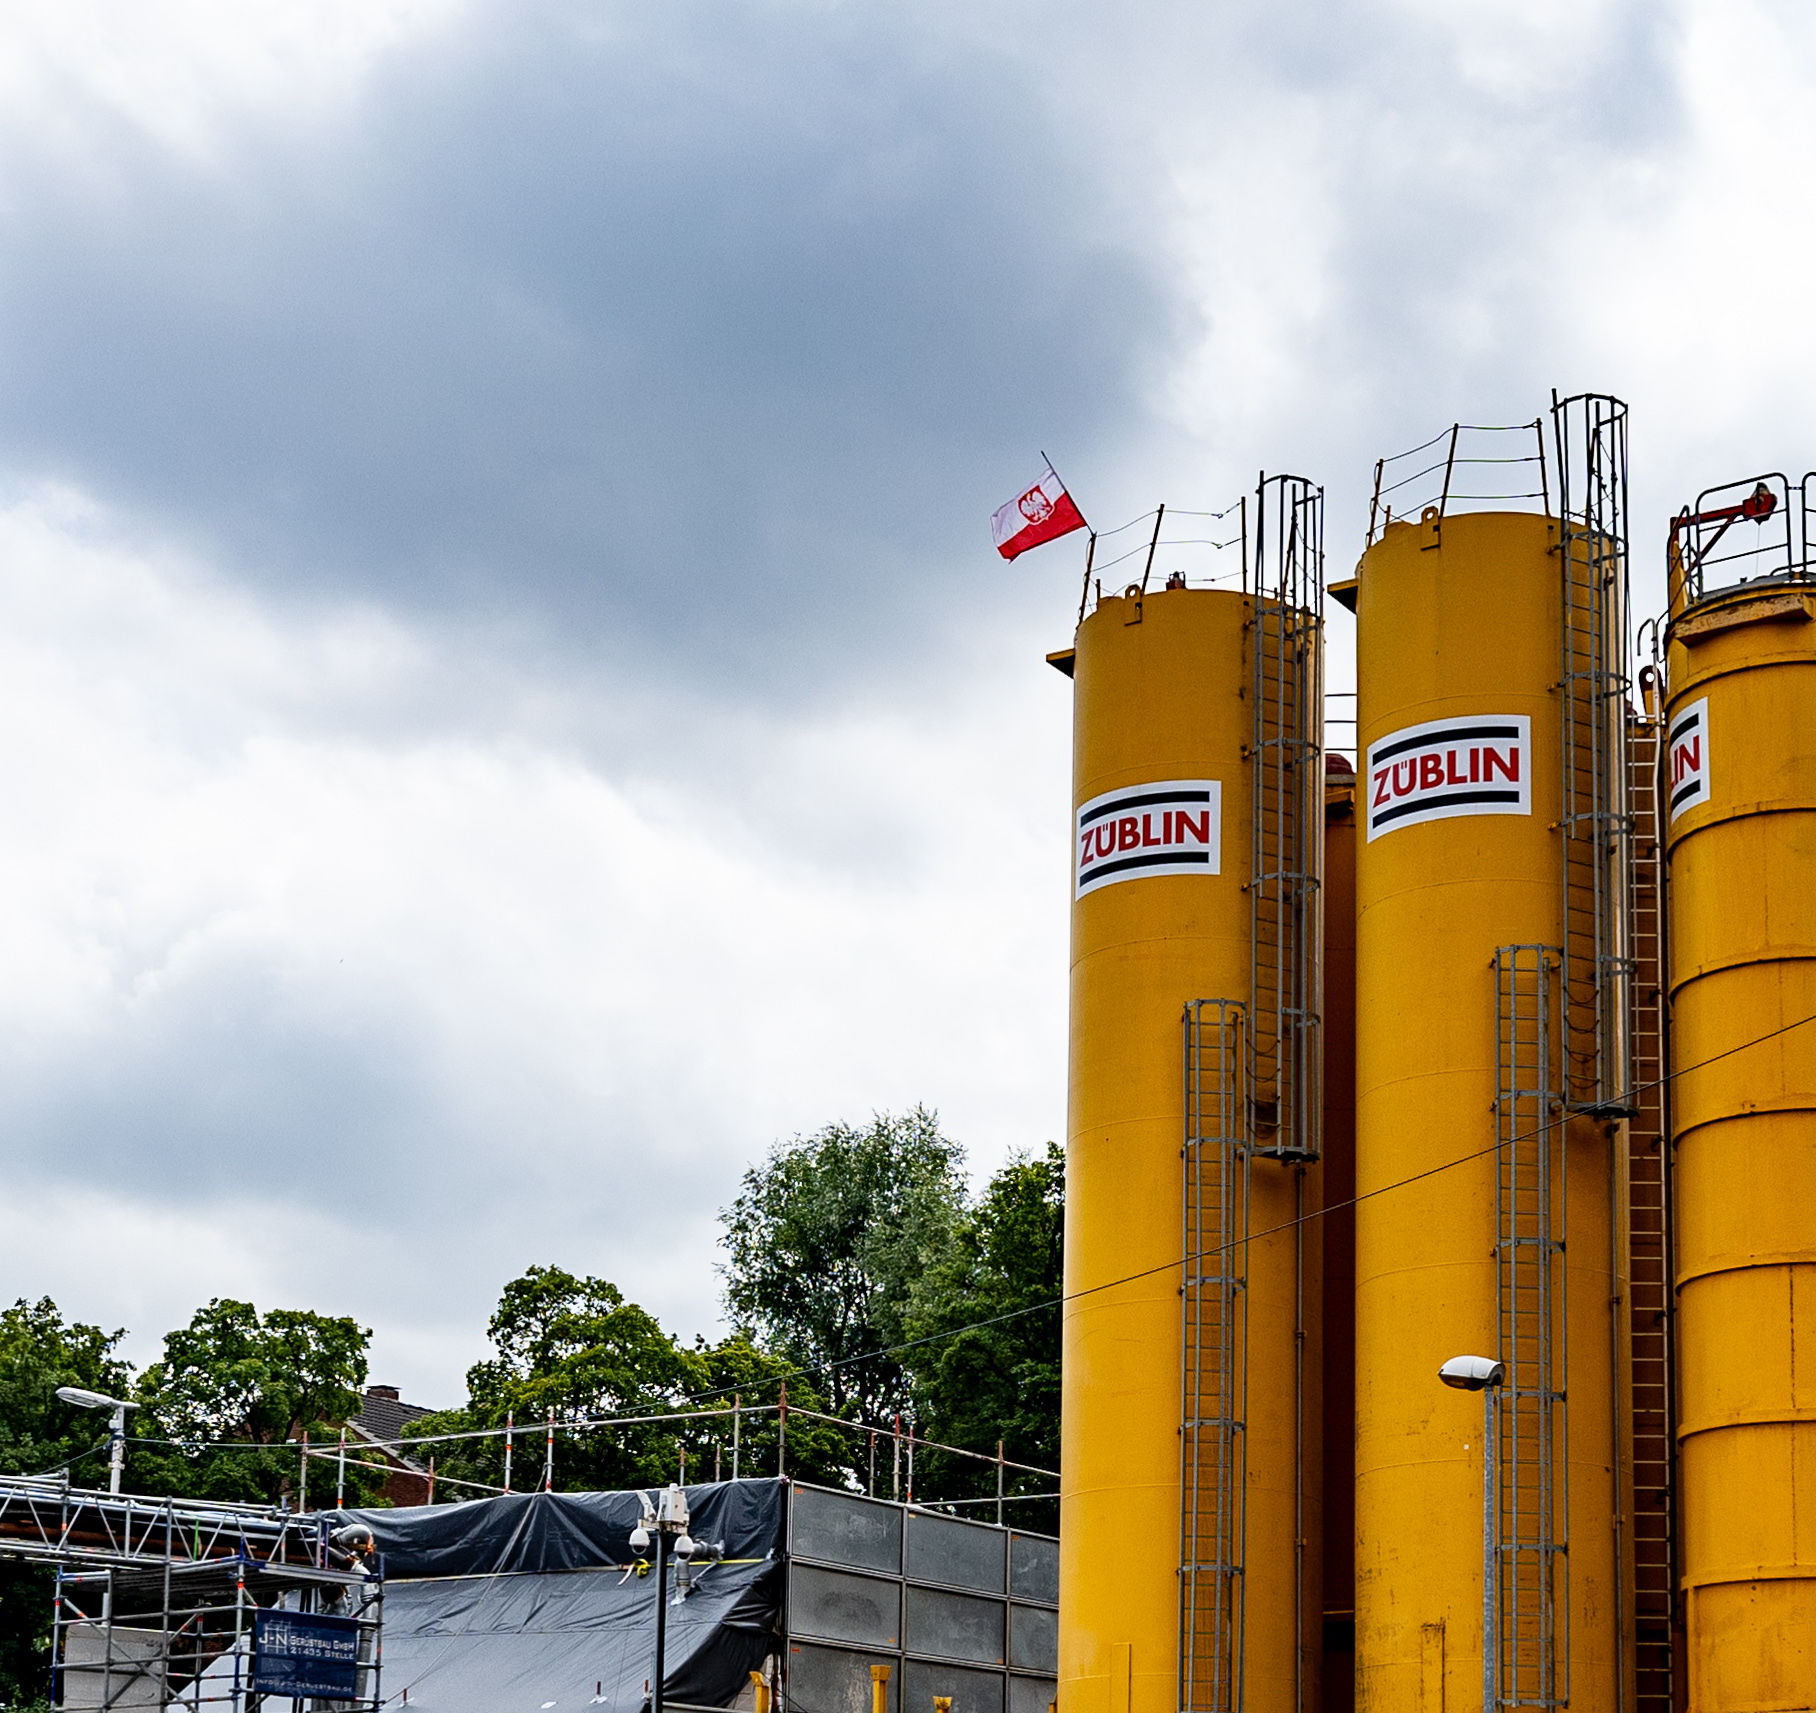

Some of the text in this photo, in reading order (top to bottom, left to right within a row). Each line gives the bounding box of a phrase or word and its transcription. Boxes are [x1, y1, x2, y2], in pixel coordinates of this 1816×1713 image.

[1373, 747, 1519, 808] ZÜBLIN
[1671, 735, 1700, 789] IN
[1080, 810, 1209, 868] ZÜBLIN
[290, 1646, 322, 1657] 21435
